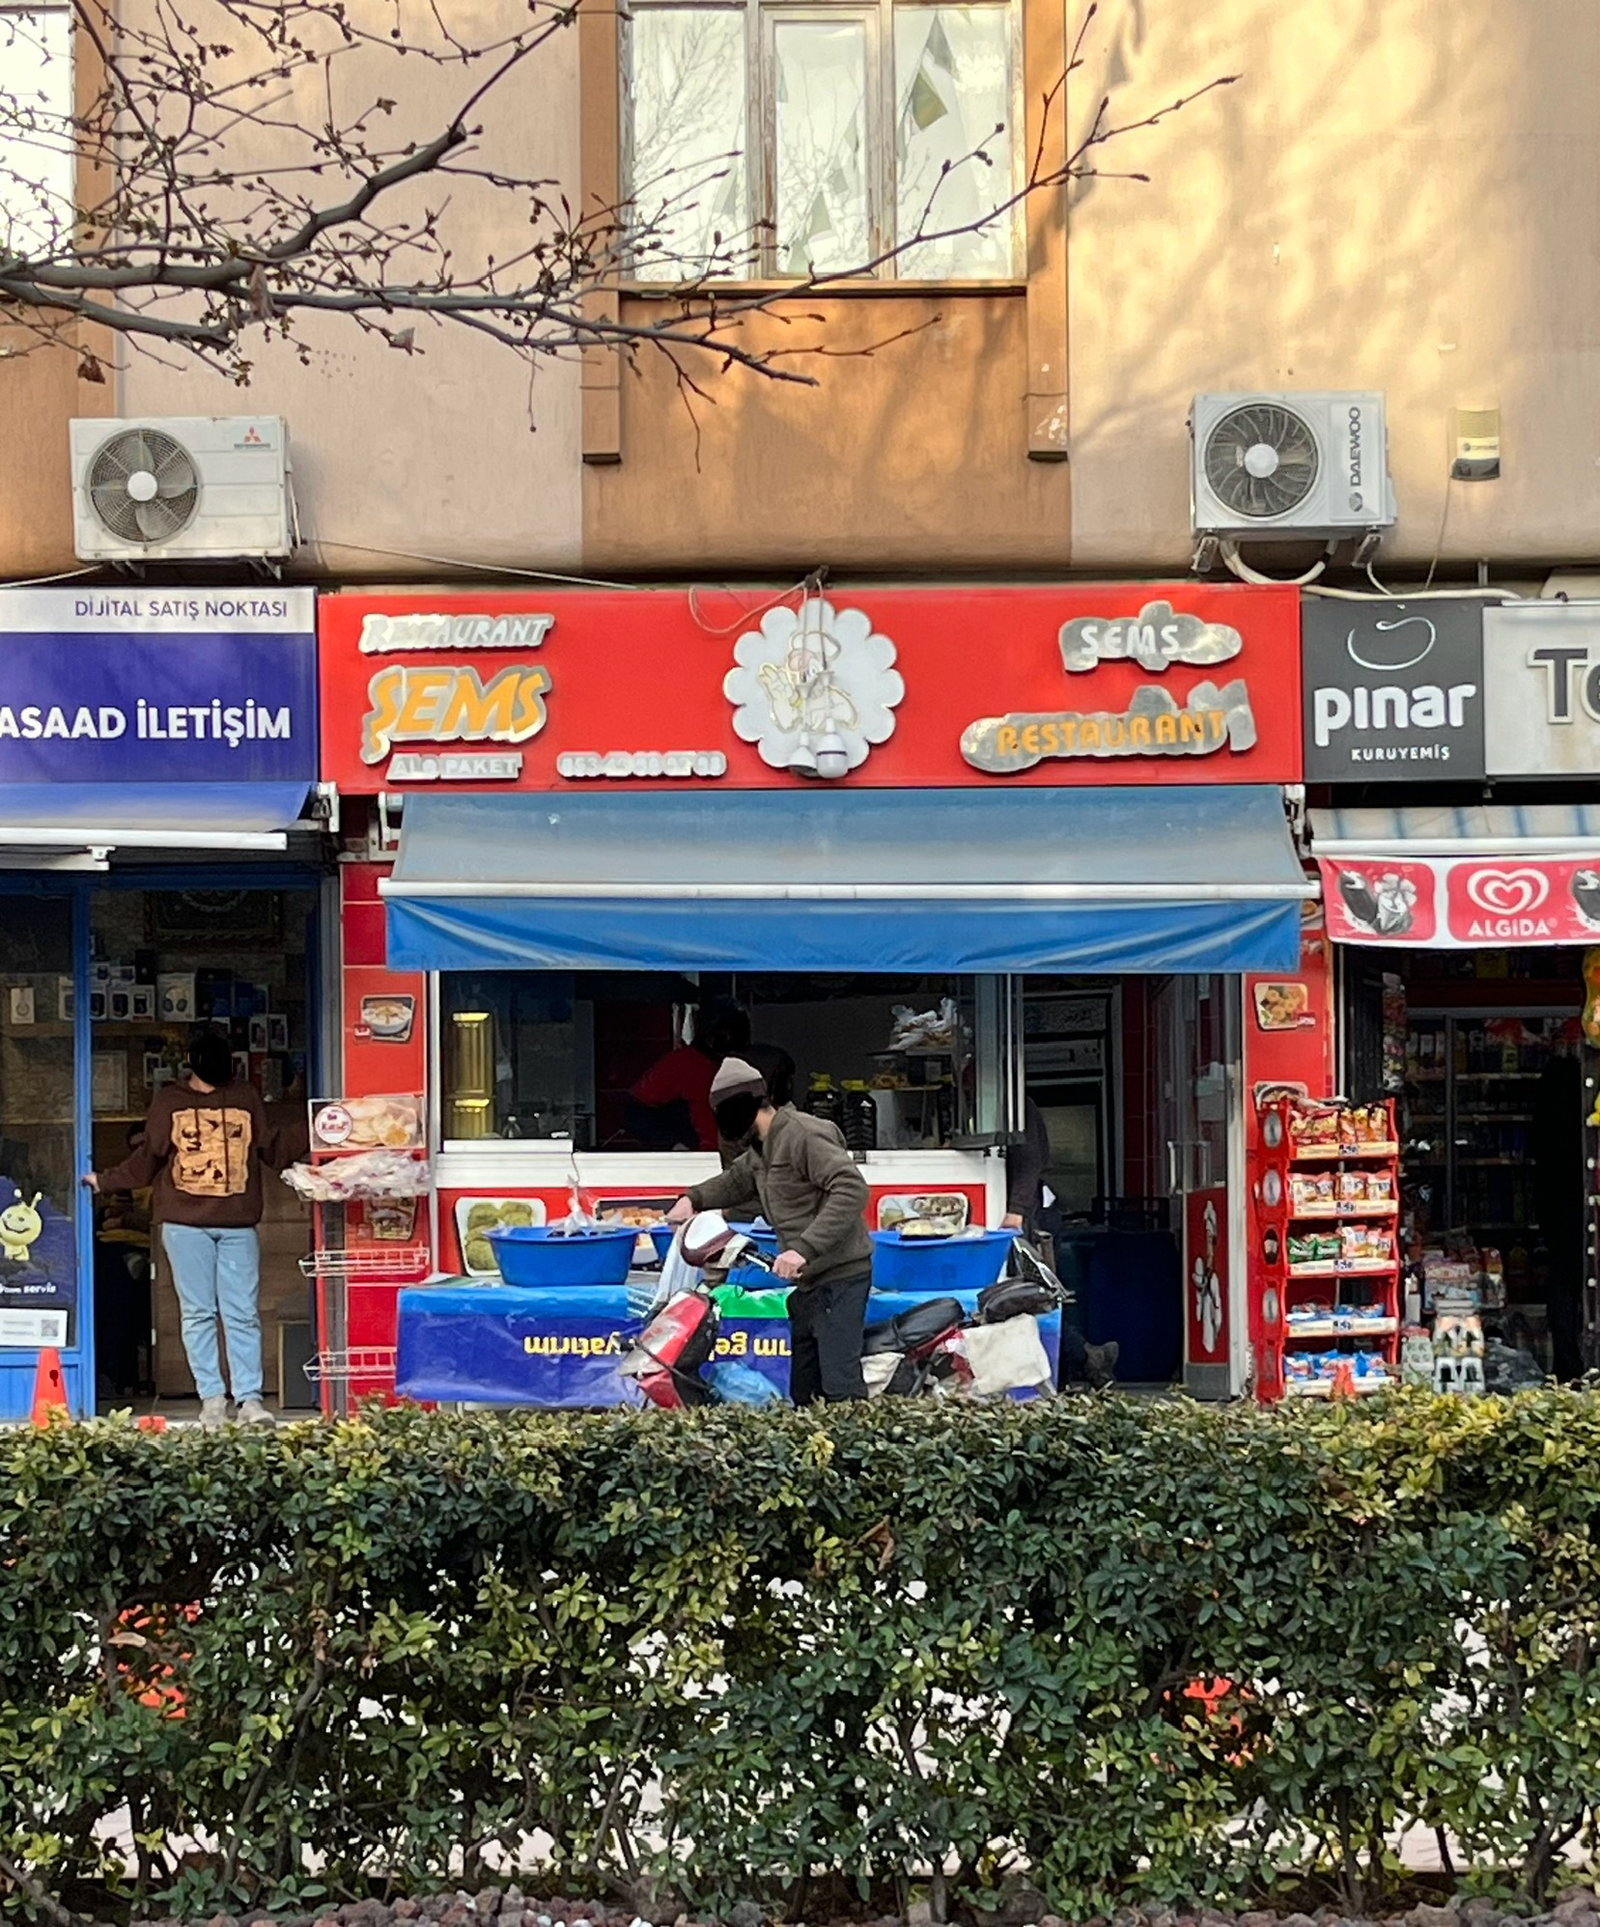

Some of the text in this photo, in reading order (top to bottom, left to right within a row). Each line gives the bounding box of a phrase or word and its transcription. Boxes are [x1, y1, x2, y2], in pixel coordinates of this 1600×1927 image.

[1349, 406, 1361, 486] DAEWOO
[75, 595, 287, 620] DİJİTAL SATIŞ NOKTASI
[365, 618, 550, 648] RESTAURANT
[1080, 625, 1179, 654] SEMS
[136, 698, 291, 748] İLETİŞİM
[370, 672, 545, 752] SEMS
[997, 709, 1228, 756] RESTAURANT
[393, 758, 517, 775] ALO PAKET
[1352, 743, 1450, 761] KURUYEMİŞ
[1468, 918, 1551, 937] ALGIDA
[524, 1331, 622, 1359] yatırım
